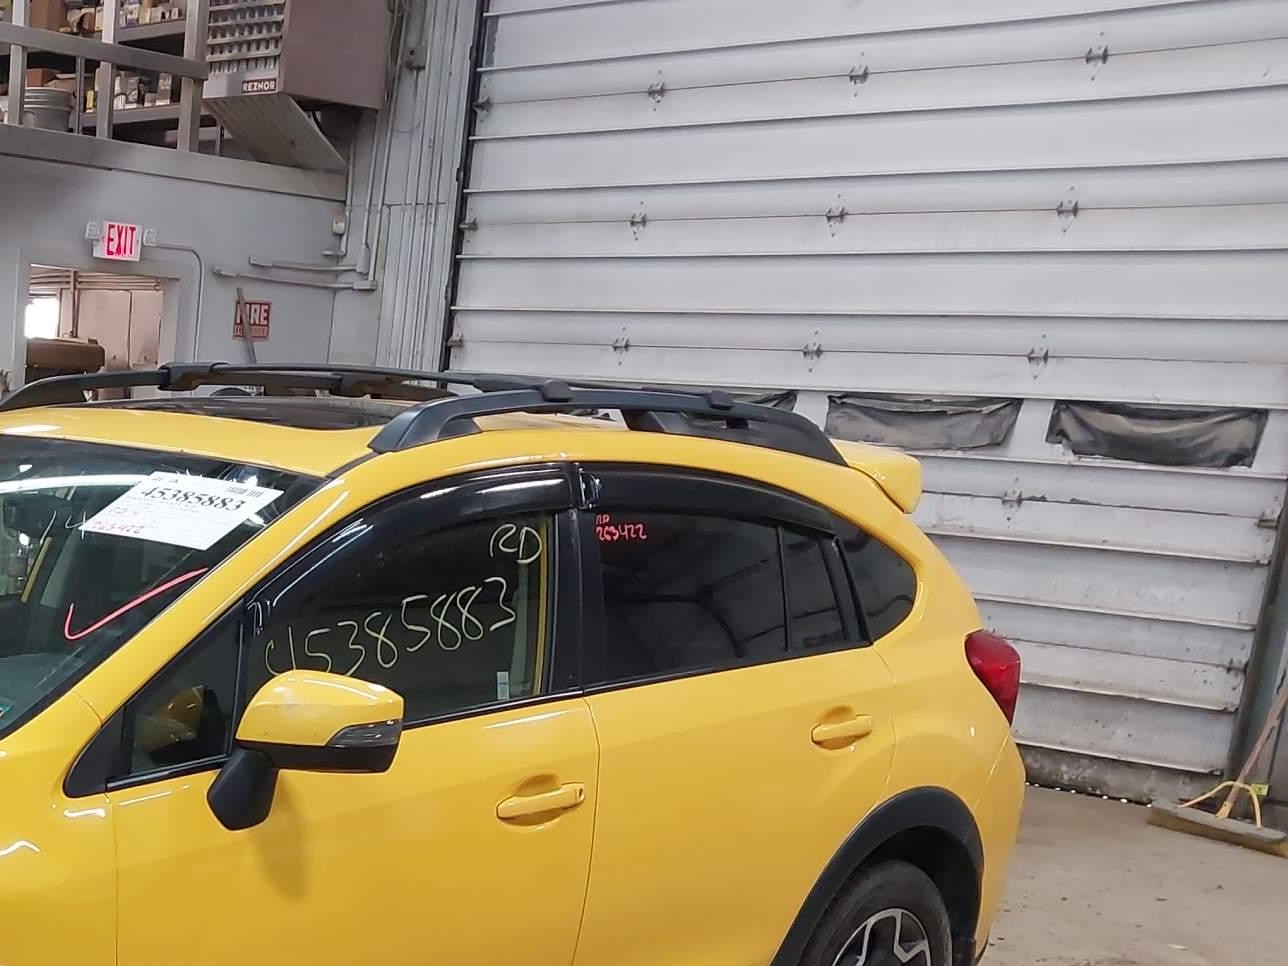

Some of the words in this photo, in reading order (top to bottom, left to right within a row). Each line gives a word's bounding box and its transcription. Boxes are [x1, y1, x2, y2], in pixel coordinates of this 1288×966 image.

[242, 80, 275, 92] REZNOR
[106, 223, 137, 257] EXIT
[141, 486, 247, 511] 45385883
[490, 524, 543, 564] RD
[265, 577, 516, 677] 45385883
